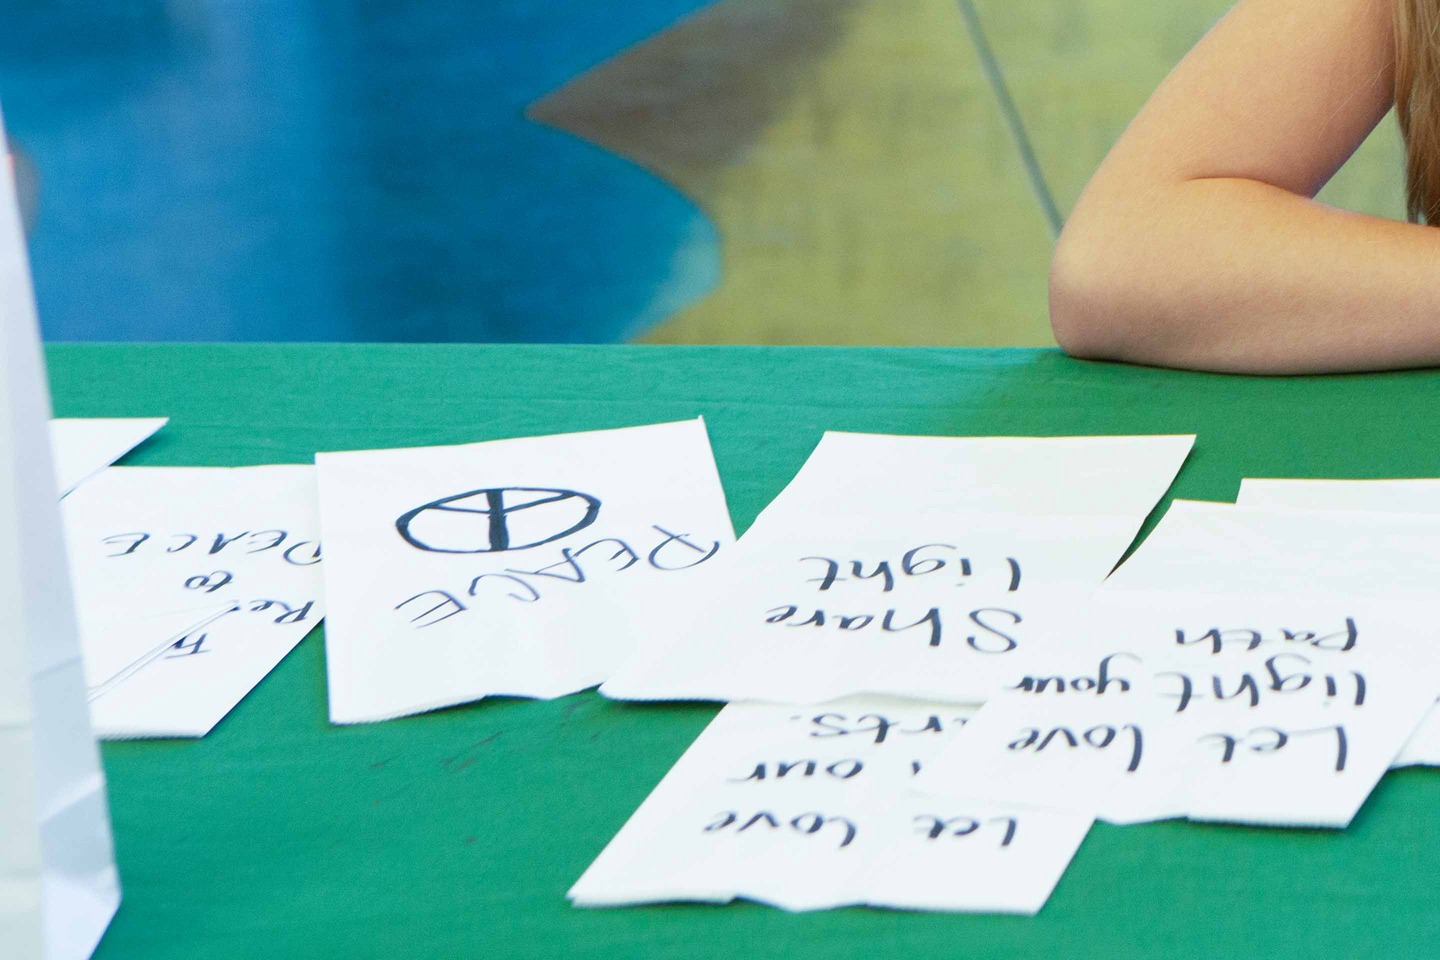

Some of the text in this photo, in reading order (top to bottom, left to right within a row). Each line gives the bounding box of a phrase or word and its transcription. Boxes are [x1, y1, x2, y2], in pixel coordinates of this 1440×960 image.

[102, 530, 321, 566] PEACE
[800, 544, 1022, 592] light
[184, 570, 235, 594] to
[394, 524, 721, 628] PEACE
[765, 604, 1023, 654] Share
[1012, 652, 1368, 713] light your
[728, 759, 864, 782] our
[1007, 723, 1349, 773] Let love
[914, 814, 1018, 847] Let
